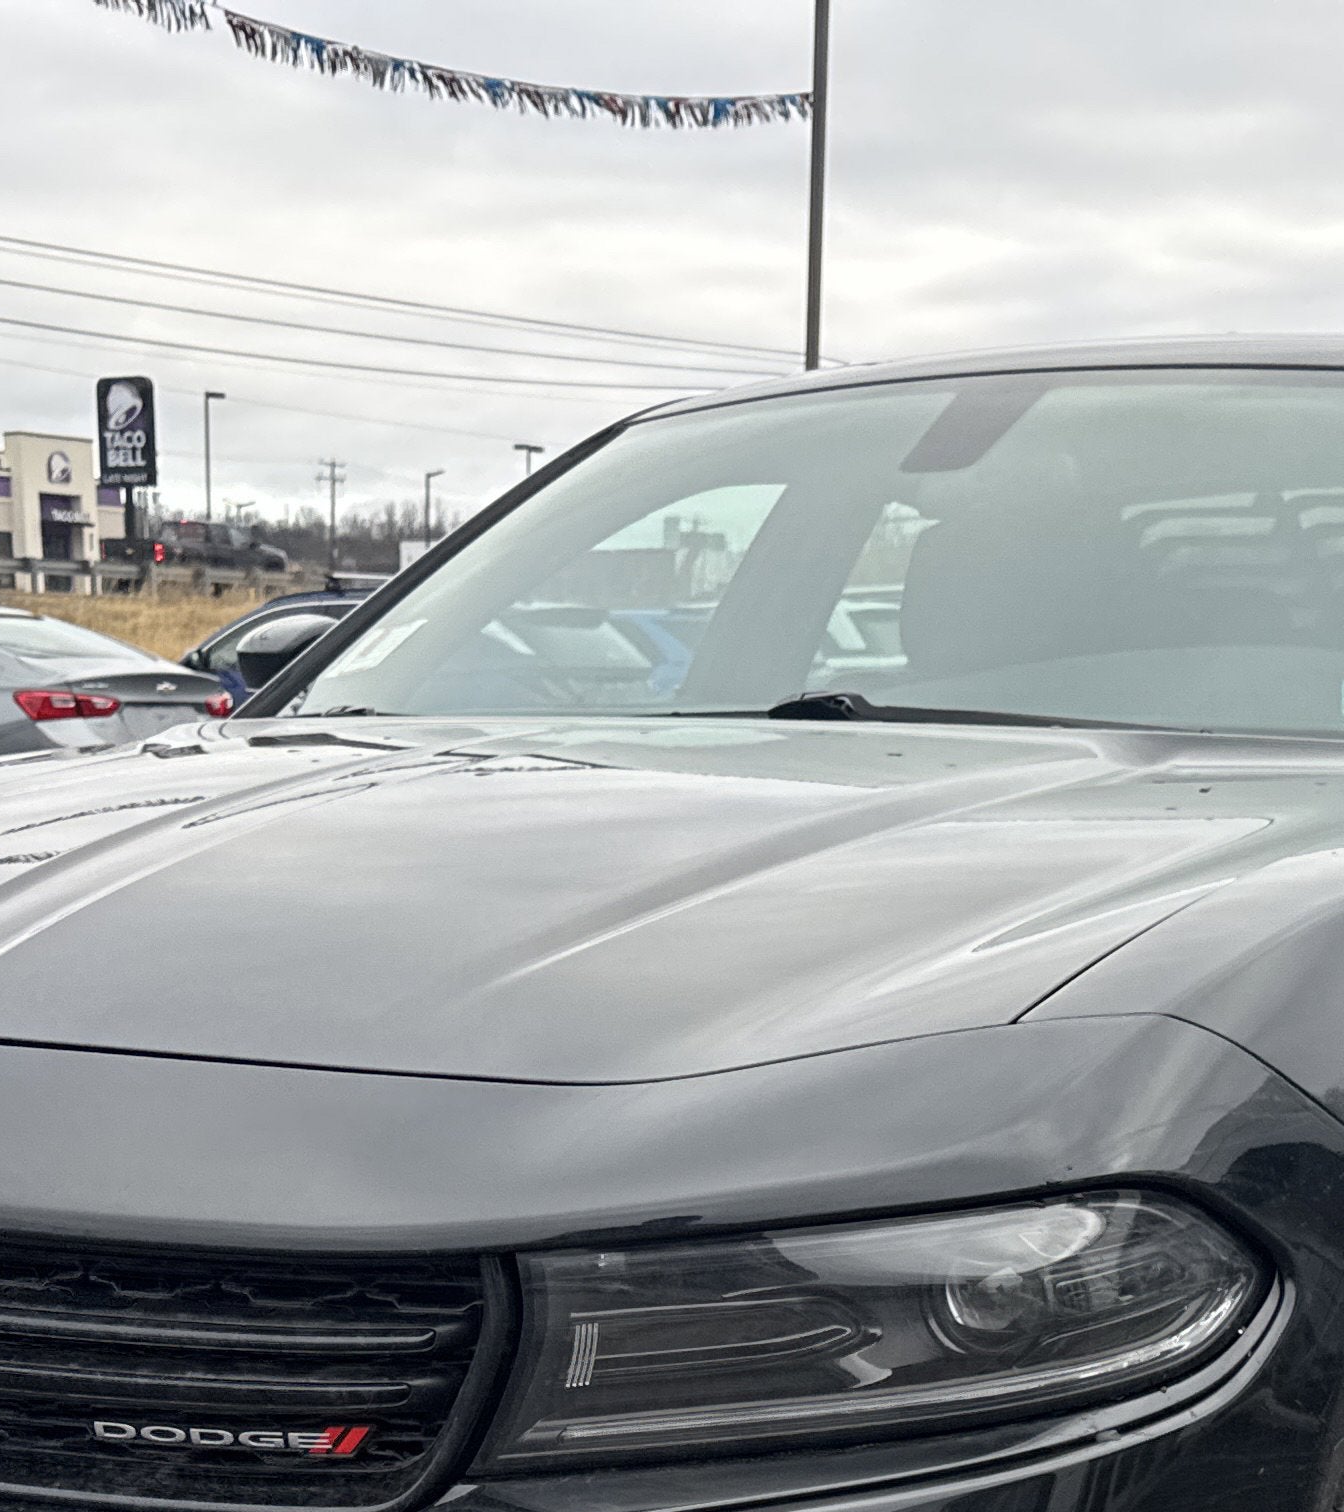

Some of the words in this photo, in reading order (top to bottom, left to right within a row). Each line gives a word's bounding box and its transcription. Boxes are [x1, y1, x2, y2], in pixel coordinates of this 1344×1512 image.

[103, 430, 147, 448] TACO
[107, 448, 147, 467] BELL
[94, 1421, 332, 1449] DODGE
